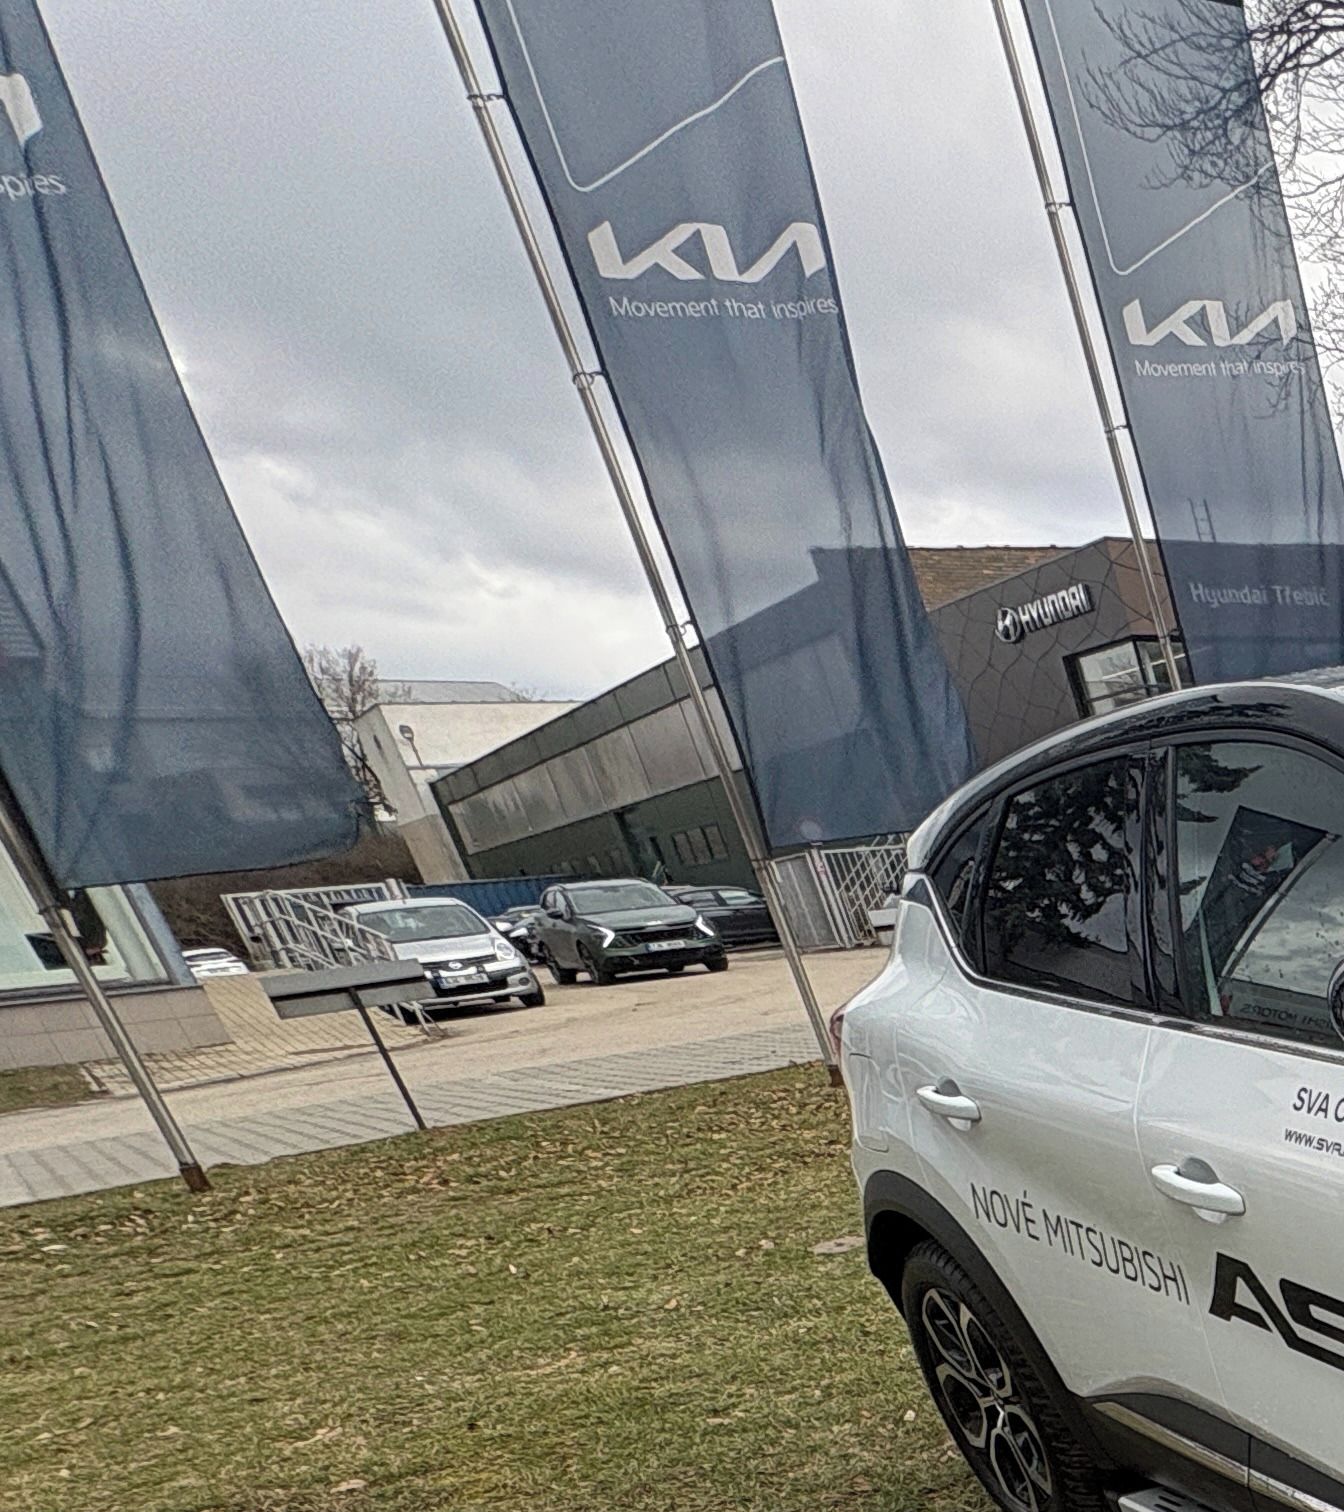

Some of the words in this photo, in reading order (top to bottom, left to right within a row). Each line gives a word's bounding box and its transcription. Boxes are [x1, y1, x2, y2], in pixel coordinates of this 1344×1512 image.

[608, 296, 720, 319] Movement
[723, 299, 766, 319] that
[772, 297, 840, 320] inspires
[1134, 359, 1217, 377] Movement
[1221, 360, 1250, 376] that
[1252, 359, 1306, 377] inspires
[1018, 583, 1088, 633] HYUNDAI
[1189, 582, 1268, 609] Hyundai
[1292, 1086, 1330, 1119] SVA
[970, 1182, 1040, 1242] NOVÉ
[1042, 1208, 1190, 1306] MITSUBISHI
